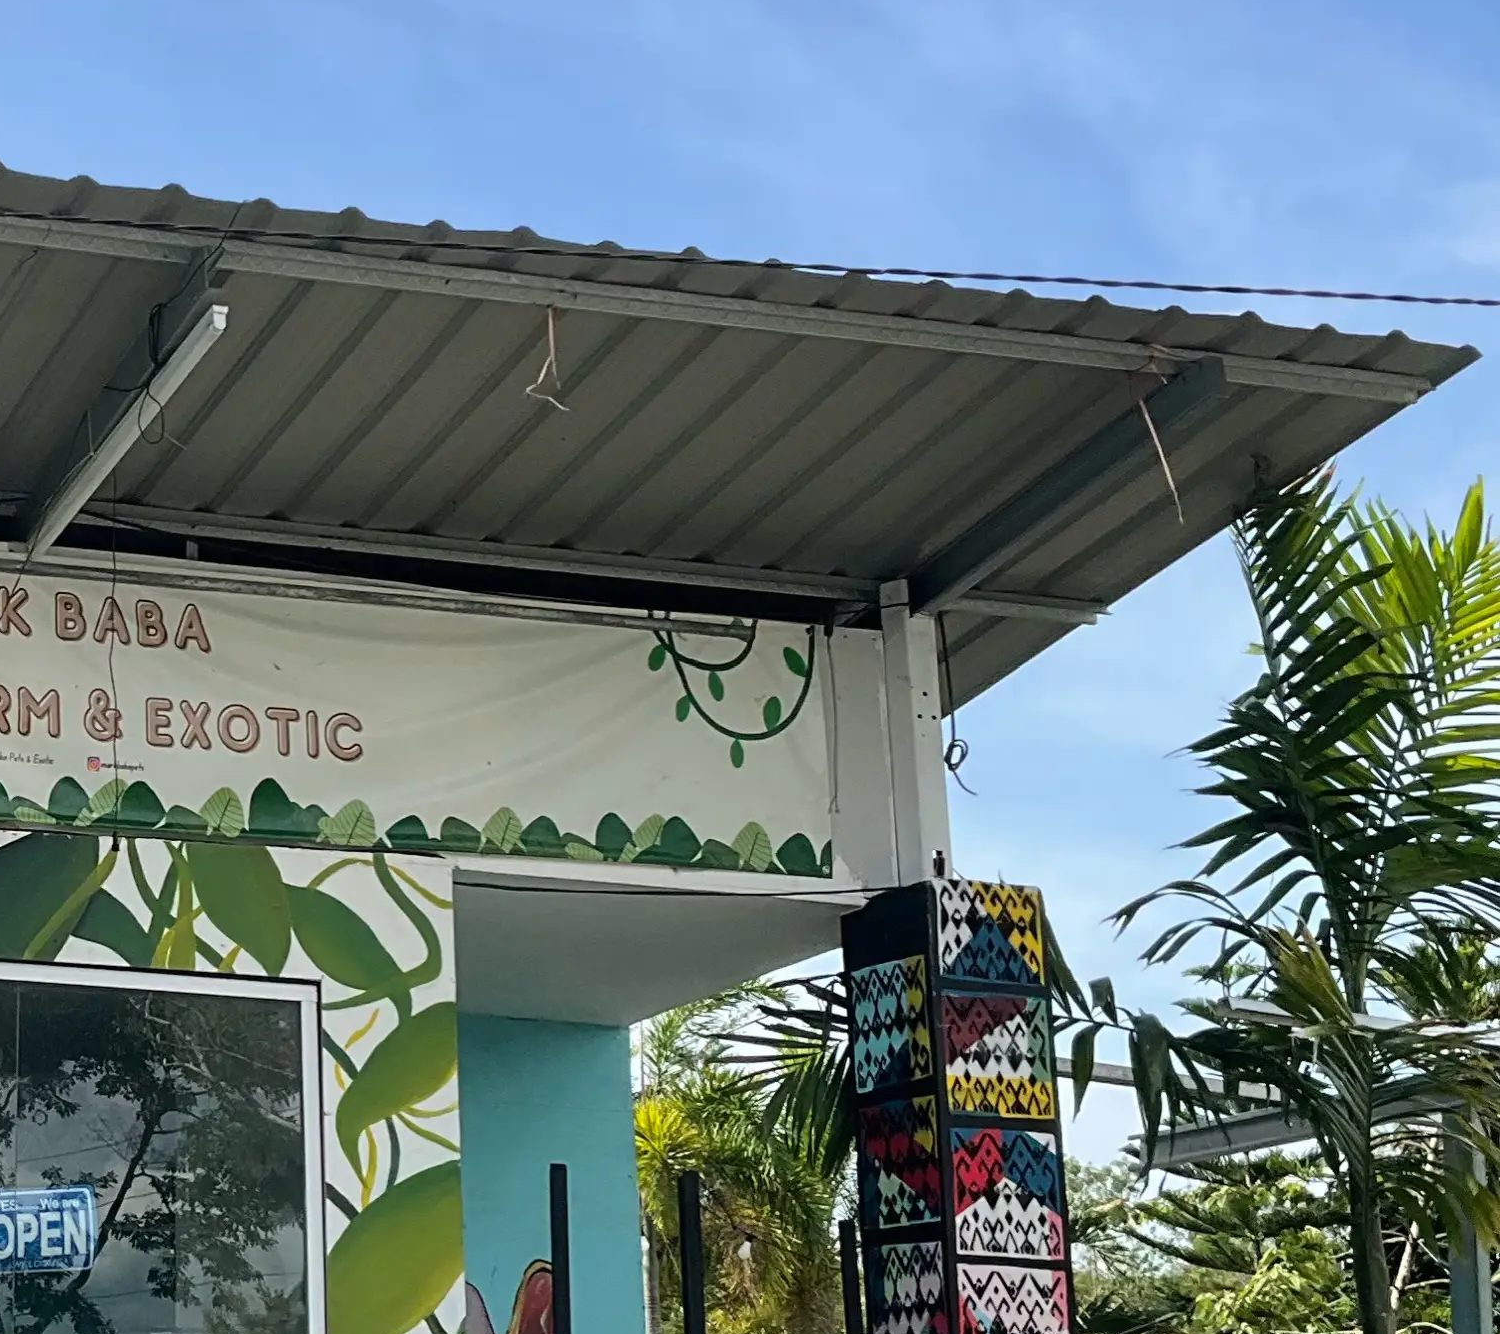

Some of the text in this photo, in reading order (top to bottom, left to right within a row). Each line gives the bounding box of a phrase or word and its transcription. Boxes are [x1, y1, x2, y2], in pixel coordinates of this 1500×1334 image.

[53, 590, 212, 654] BABA
[82, 687, 124, 743] &
[144, 696, 365, 763] EXOTIC
